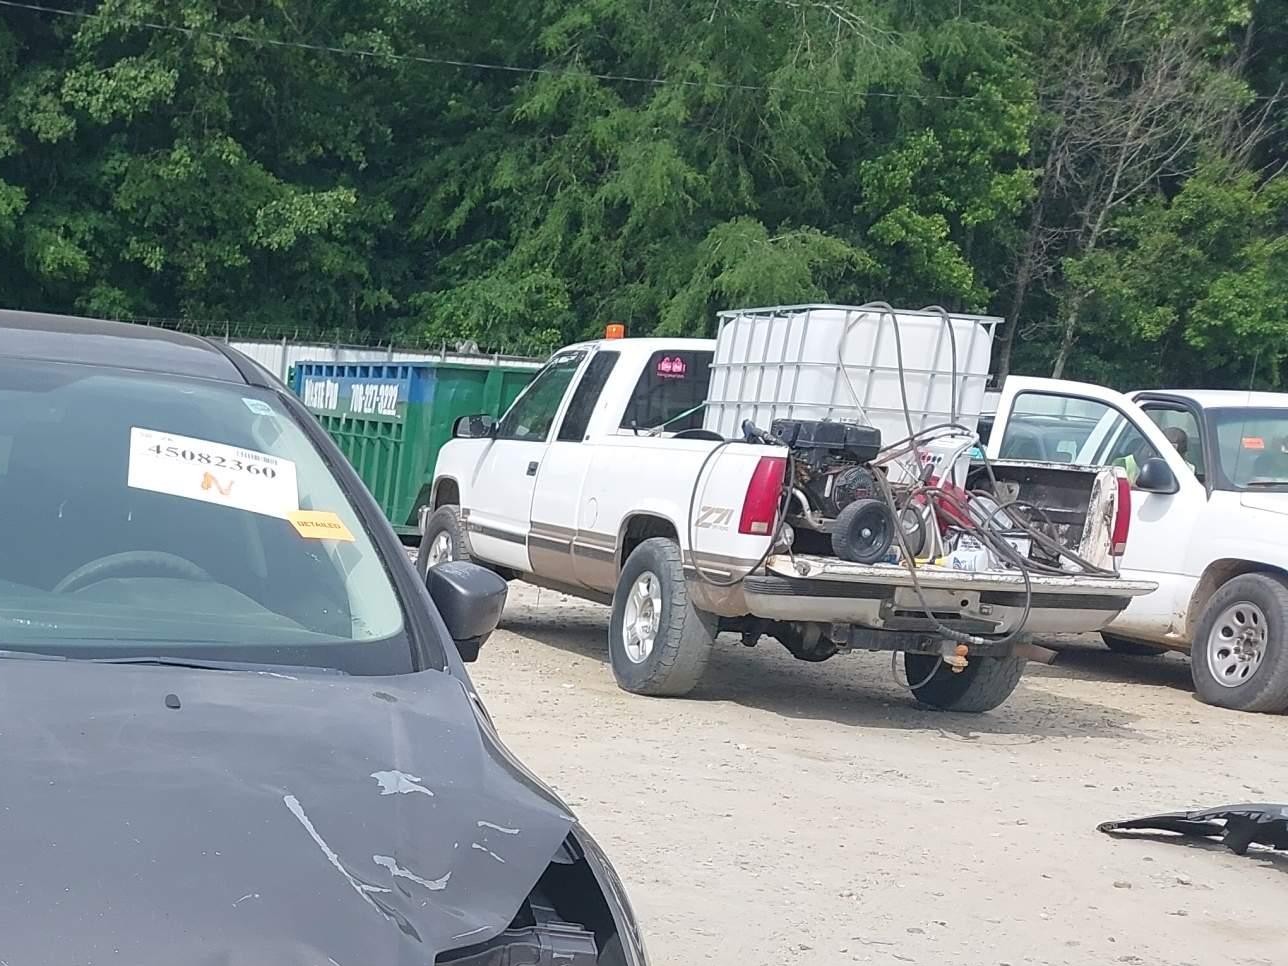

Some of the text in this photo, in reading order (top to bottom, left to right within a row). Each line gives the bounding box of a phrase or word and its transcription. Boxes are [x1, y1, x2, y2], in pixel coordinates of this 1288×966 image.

[148, 443, 277, 479] 45082360
[296, 520, 341, 530] DETAILED
[695, 505, 735, 529] Z71
